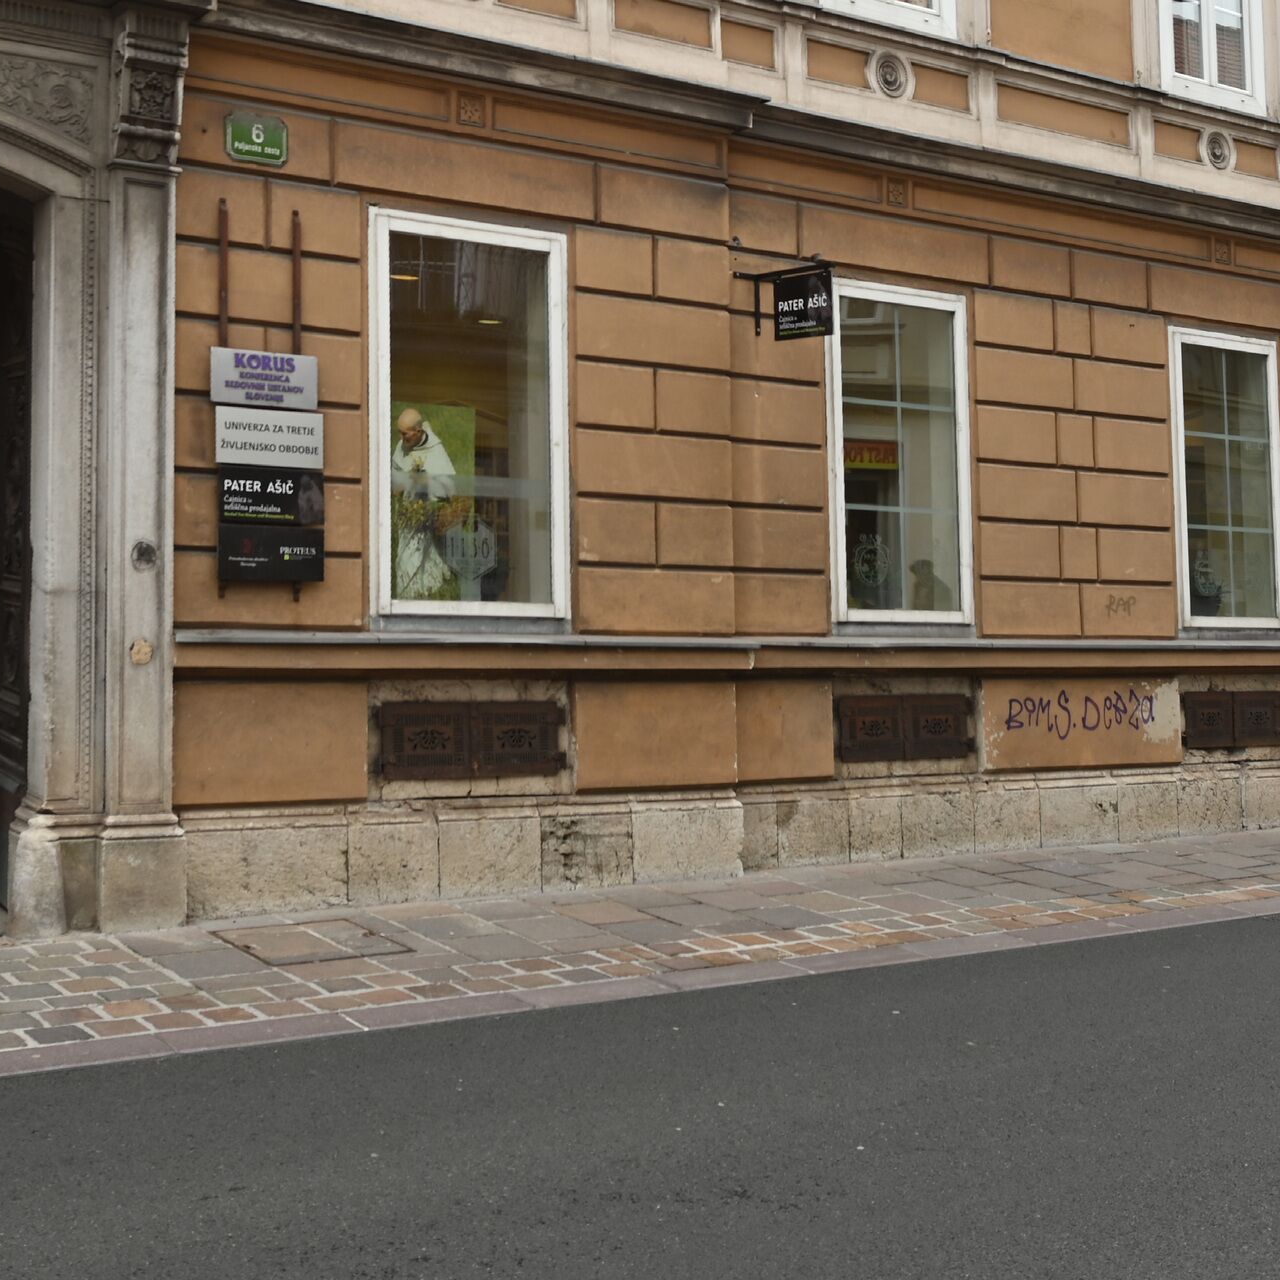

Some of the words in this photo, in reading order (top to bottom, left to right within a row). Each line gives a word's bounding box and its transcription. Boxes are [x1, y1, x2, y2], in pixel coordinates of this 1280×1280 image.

[252, 124, 265, 143] 6
[778, 298, 804, 312] PATER
[807, 292, 827, 309] AŠIČ
[234, 352, 297, 374] KORUS
[224, 421, 271, 434] UNIVERZA
[272, 425, 284, 434] ZA
[286, 425, 316, 437] TRETJE
[220, 438, 277, 453] ŽIVLJENJSKO
[278, 444, 320, 456] OBDOBJE
[223, 479, 262, 493] PATER
[266, 479, 295, 495] AŠIČ
[280, 546, 317, 556] PROTEUS
